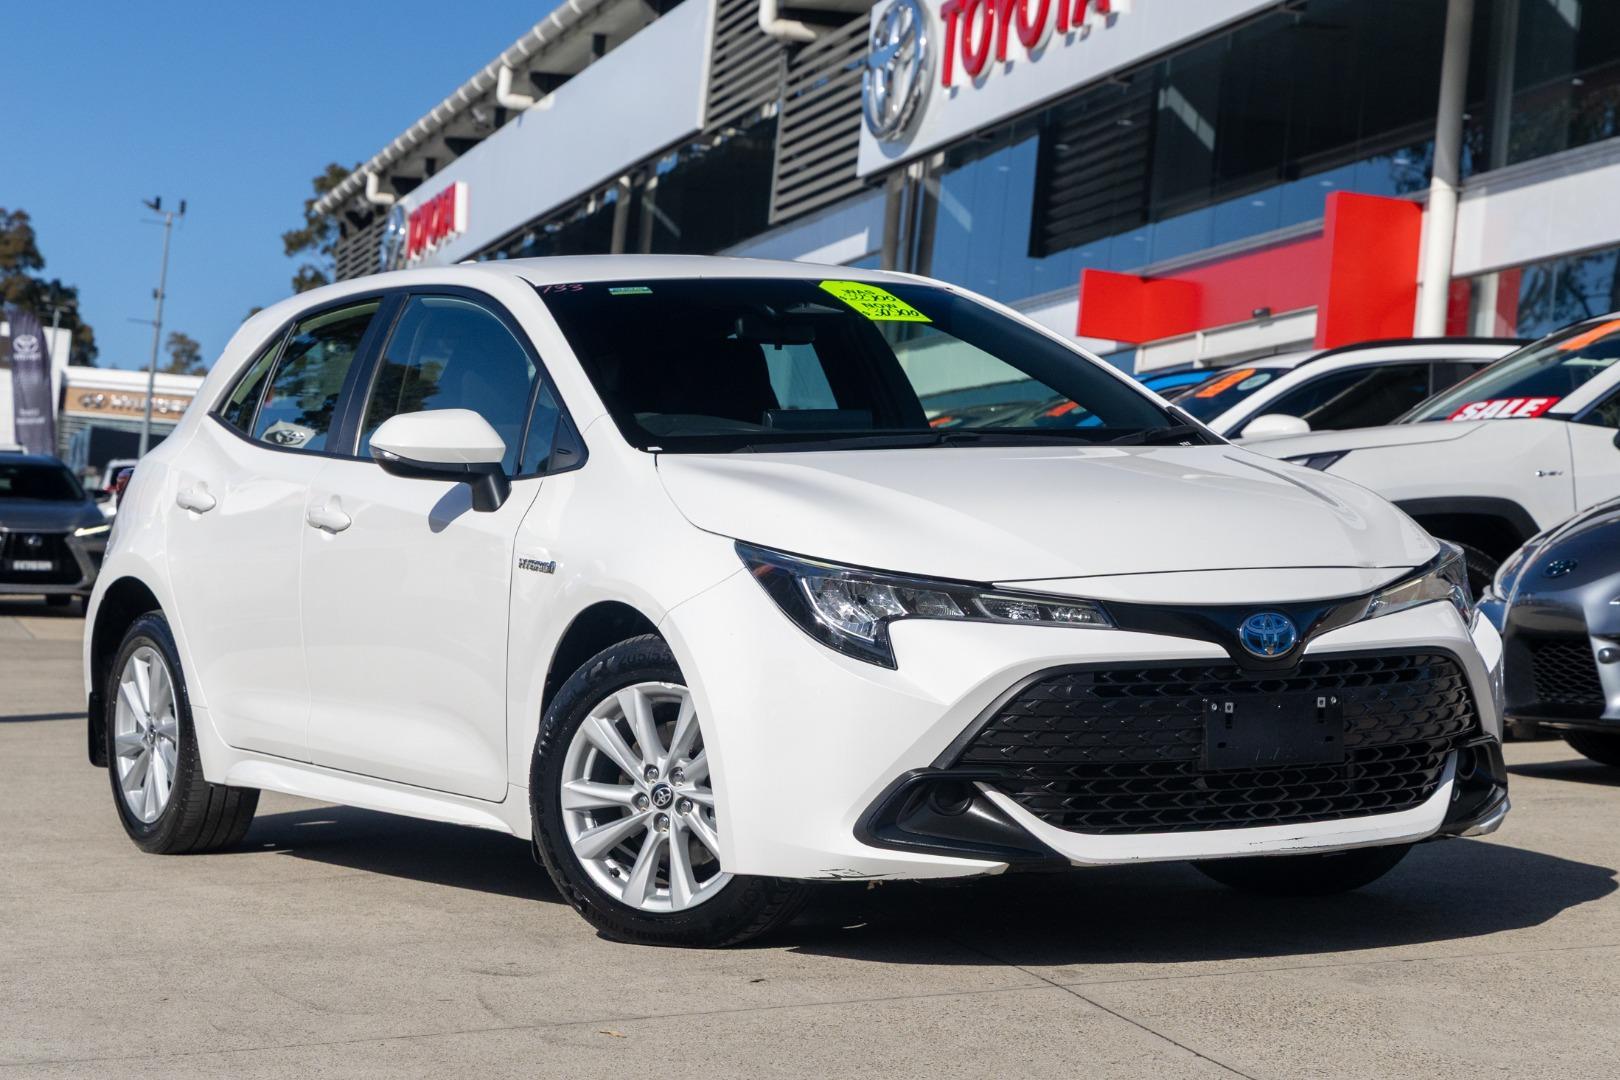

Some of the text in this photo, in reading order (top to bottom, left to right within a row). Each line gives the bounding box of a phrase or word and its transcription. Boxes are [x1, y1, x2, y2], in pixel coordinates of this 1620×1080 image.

[941, 0, 1111, 88] TOYO
[405, 182, 457, 259] TOYOTA
[1452, 398, 1549, 422] SALE
